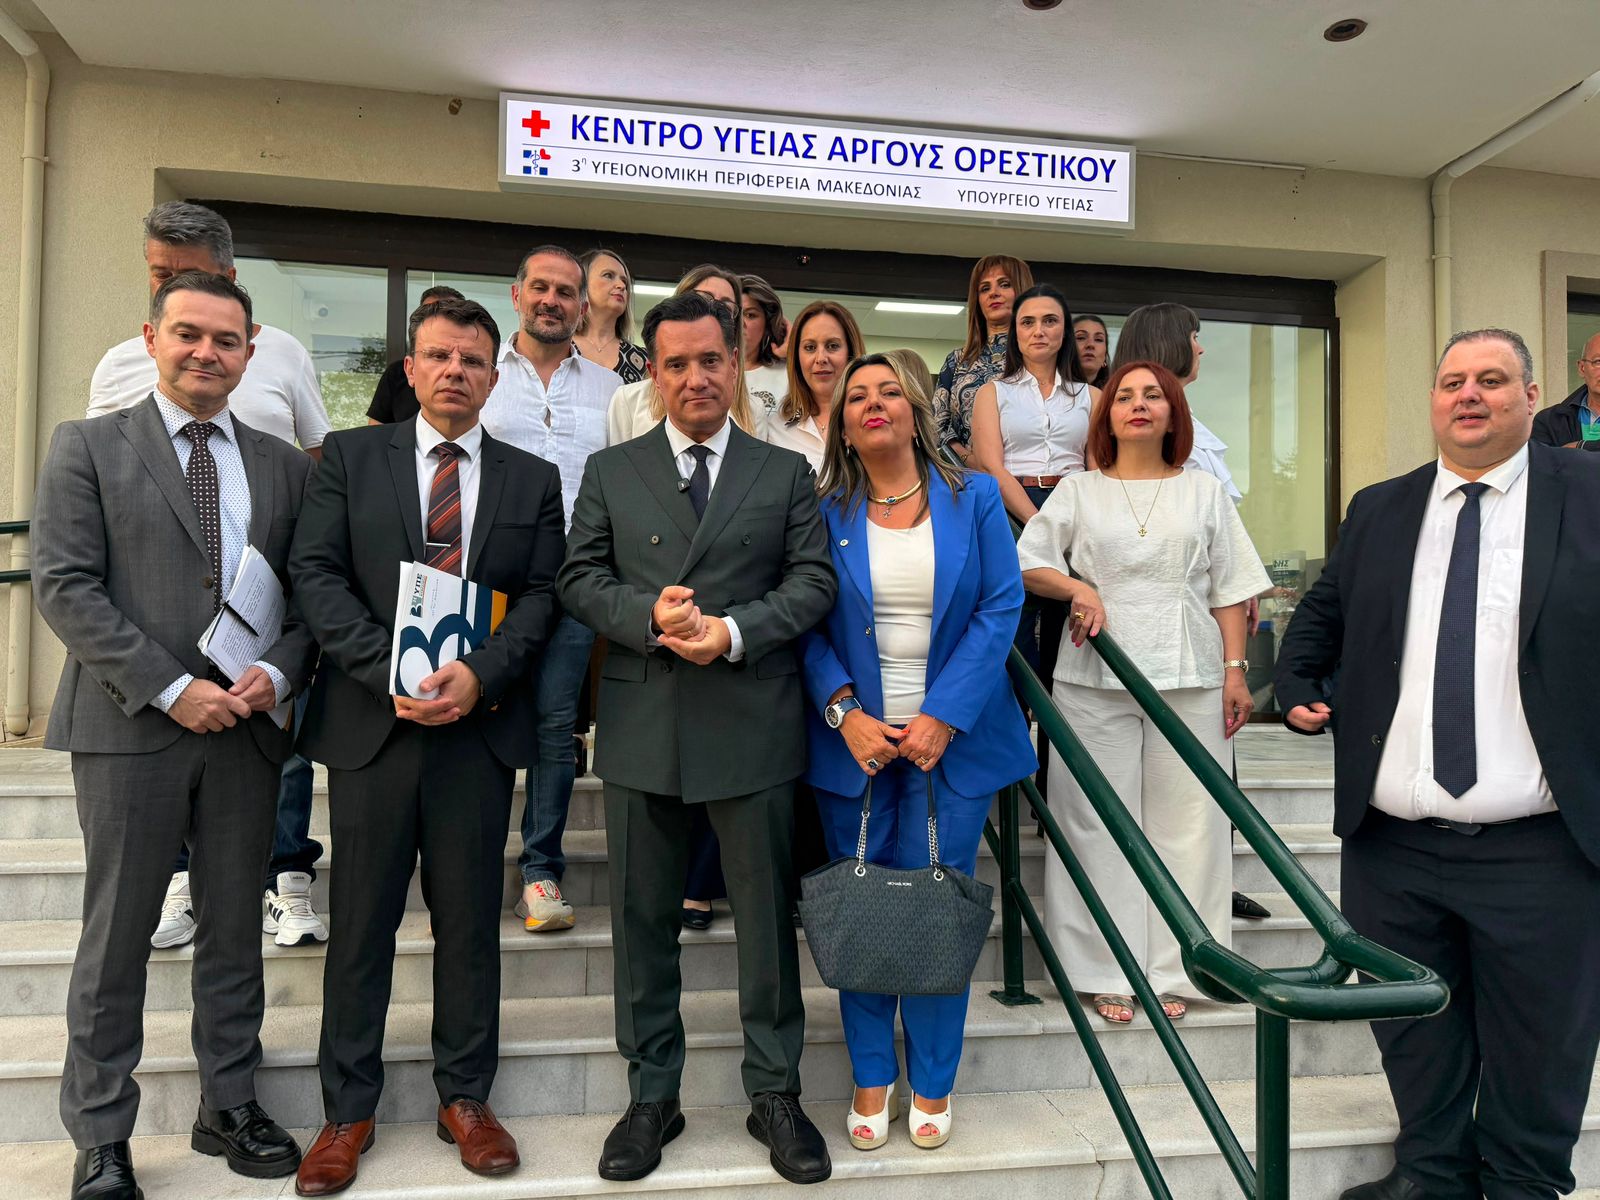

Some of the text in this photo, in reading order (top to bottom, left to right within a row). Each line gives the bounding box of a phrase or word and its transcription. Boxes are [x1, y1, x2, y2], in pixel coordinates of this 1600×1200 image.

[571, 114, 1117, 183] ΚΕΝΤΡΟ ΥΓΕΙΑΣ ΑΡΓΟΥΣ ΟΡΕΣΤΙΚΟΥ
[592, 160, 708, 182] ΥΓΕΙΟΝΟΜΙΚΗ
[715, 170, 811, 191] ΠΕΡΙΦΕΡΕΙΑ
[817, 179, 922, 199] ΜΑΚΕΔΟΝΙΑΣ
[957, 189, 1094, 212] ΥΠΟΥΡΓΕΙΟ ΥΓΕΙΑΣ
